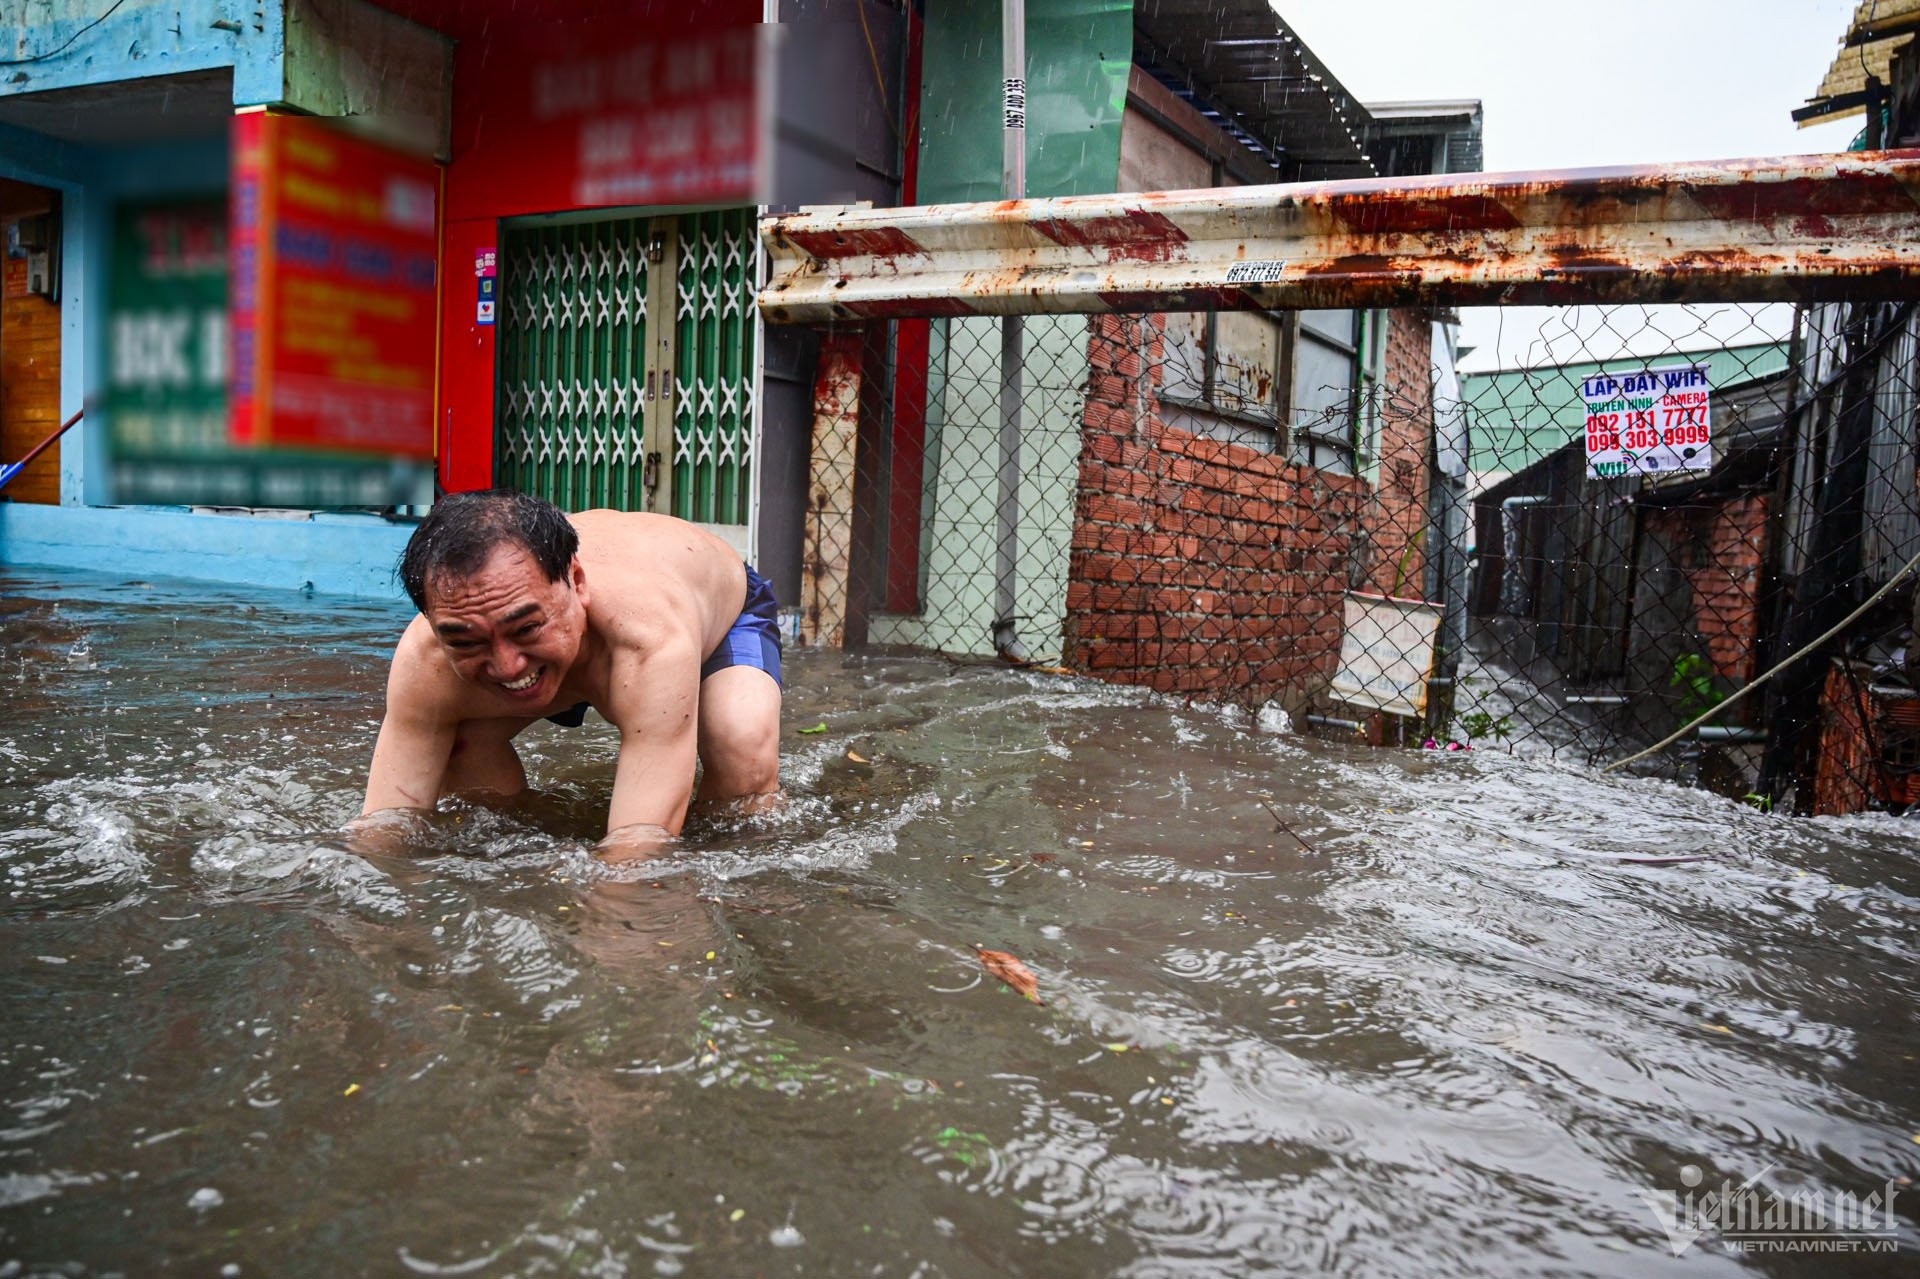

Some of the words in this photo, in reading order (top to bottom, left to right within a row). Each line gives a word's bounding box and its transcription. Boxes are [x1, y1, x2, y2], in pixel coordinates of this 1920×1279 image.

[1006, 79, 1024, 93] 355
[1006, 95, 1024, 108] 400
[1006, 110, 1024, 128] 0967
[1664, 370, 1706, 388] WIFI
[1663, 392, 1707, 406] CAMERA
[1587, 414, 1619, 433] 092
[1663, 406, 1707, 427] 7777
[1626, 429, 1658, 449] 303
[1664, 425, 1708, 446] 9999
[1594, 461, 1628, 476] Wifi
